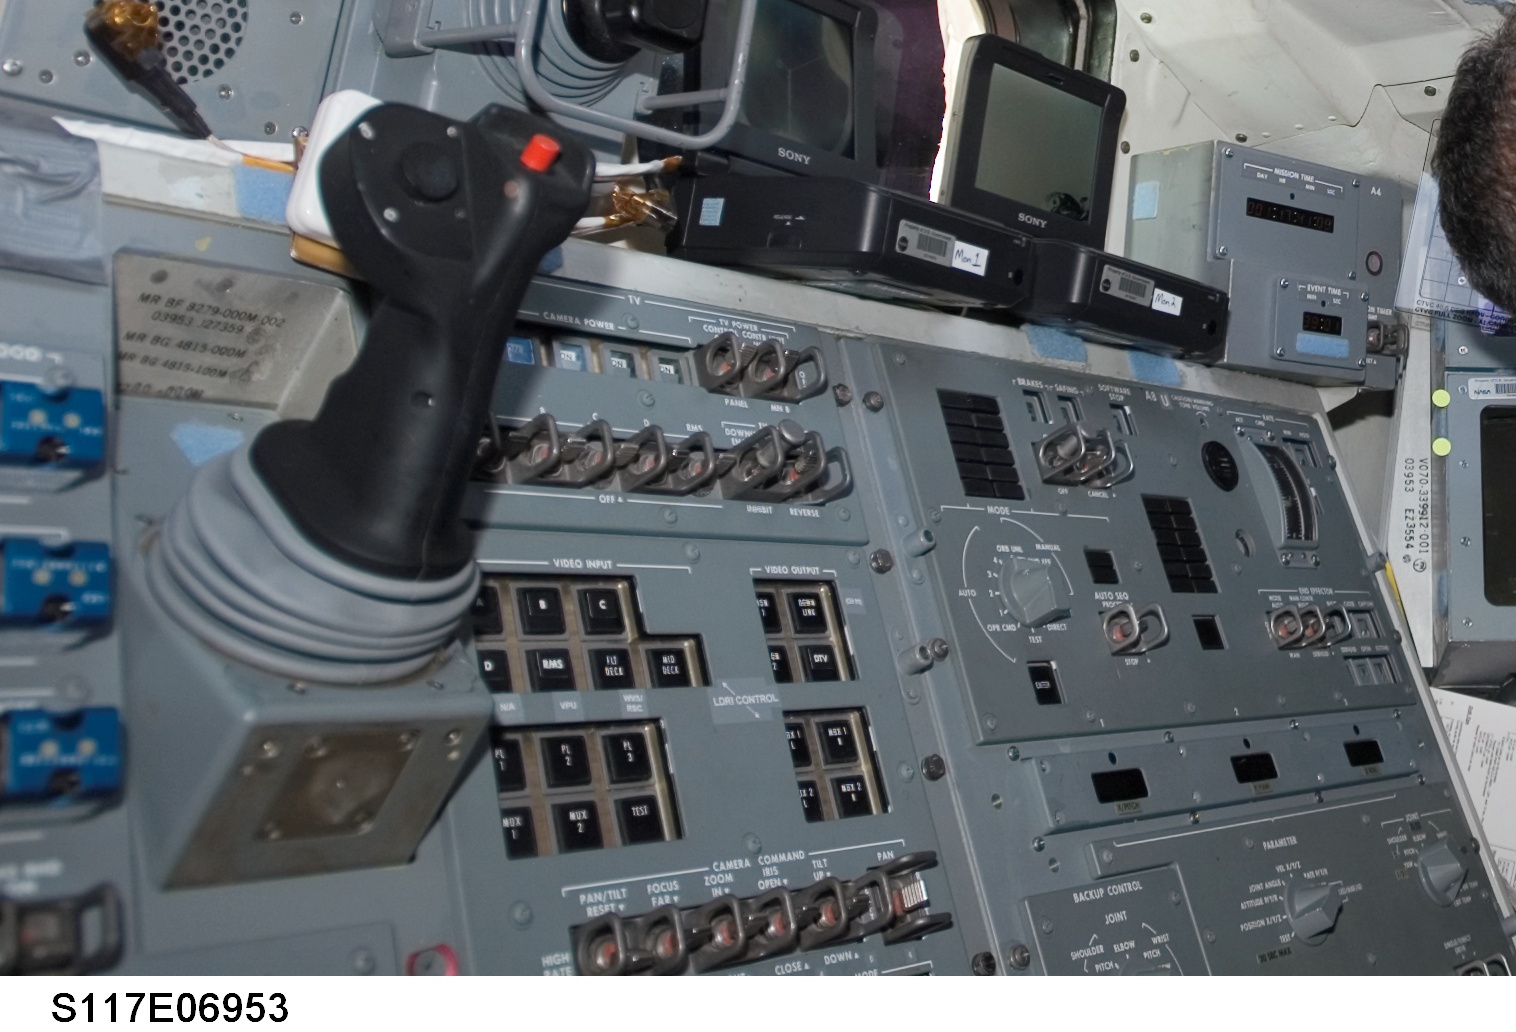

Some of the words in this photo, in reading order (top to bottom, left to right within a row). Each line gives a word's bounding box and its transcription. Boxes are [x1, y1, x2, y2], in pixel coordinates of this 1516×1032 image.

[778, 147, 811, 165] SONY
[1273, 167, 1300, 180] MISSION
[1300, 173, 1315, 183] TIME
[1370, 186, 1382, 197] A4
[1018, 212, 1047, 229] SONY
[1307, 284, 1327, 294] EVENT
[1327, 286, 1342, 295] TIME
[138, 292, 161, 304] MR
[164, 298, 184, 308] BF
[628, 295, 641, 305] TV
[1154, 293, 1170, 307] Mon
[1416, 300, 1434, 308] CTVC
[1377, 307, 1393, 316] TIMER
[543, 311, 581, 326] CAMERA
[584, 318, 615, 331] POWER
[1453, 314, 1473, 322] ZOOM
[719, 318, 730, 326] TV
[731, 320, 758, 332] POWER
[123, 331, 147, 343] MR
[150, 335, 171, 347] BG
[560, 352, 573, 361] ON
[611, 360, 623, 368] ON
[660, 366, 671, 374] ON
[1017, 377, 1043, 390] BRAKES
[1054, 384, 1079, 395] SAFING
[1098, 384, 1132, 396] SOFTWARE
[1109, 393, 1124, 402] STOP
[1145, 390, 1158, 402] A8
[724, 398, 749, 409] PANEL
[643, 419, 650, 427] D
[1404, 458, 1414, 493] 03953
[599, 495, 614, 503] OFF
[746, 505, 773, 514] INHIBIT
[789, 507, 820, 517] REVERSE
[987, 505, 1011, 515] MODE
[1405, 509, 1415, 549] EZ3554
[1035, 544, 1061, 552] MANUAL
[553, 558, 582, 568] VIDEO
[586, 560, 612, 569] INPUT
[764, 565, 787, 574] VIDEO
[791, 566, 820, 575] OUTPUT
[959, 589, 976, 597] AUTO
[1095, 592, 1113, 600] AUTO
[1115, 592, 1129, 601] SEQ
[539, 600, 548, 609] B
[599, 600, 607, 609] C
[814, 655, 828, 663] DTV
[484, 662, 494, 671] D
[542, 660, 563, 669] RMS
[713, 697, 734, 706] LDRI
[736, 694, 779, 705] CONTROL
[500, 703, 516, 711] N/A
[559, 702, 578, 710] VPU
[561, 744, 571, 754] PL
[623, 741, 632, 751] PL
[494, 749, 505, 759] PL
[631, 806, 648, 816] TEST
[1117, 802, 1141, 811] X/PITCH
[569, 810, 588, 821] MUX
[1263, 836, 1297, 851] PARAMETER
[712, 857, 750, 872] CAMERA
[757, 850, 805, 866] COMMAND
[579, 888, 627, 906] PAN/TILT
[646, 880, 680, 895] FOCUS
[704, 873, 733, 886] ZOOM
[762, 866, 779, 877] IRIS
[811, 858, 828, 869] TILT
[876, 850, 895, 862] PAN
[586, 903, 616, 918] RESET
[651, 895, 671, 908] FAR
[711, 887, 722, 898] IN
[757, 878, 782, 890] OPEN
[813, 871, 825, 881] UP
[1072, 888, 1104, 903] BACKUP
[1107, 880, 1143, 897] CONTROL
[1105, 910, 1127, 925] JOINT
[1240, 919, 1265, 932] POSITION
[1280, 934, 1290, 943] TEST
[1071, 945, 1104, 960] SHOULDER
[1113, 941, 1135, 953] ELBOW
[1152, 933, 1169, 945] WRIST
[1279, 948, 1291, 957] MAX
[541, 952, 569, 967] HIGH
[774, 962, 803, 976] CLOSE
[824, 951, 853, 965] DOWN
[1095, 961, 1114, 973] PITCH
[1143, 949, 1161, 959] PITCH
